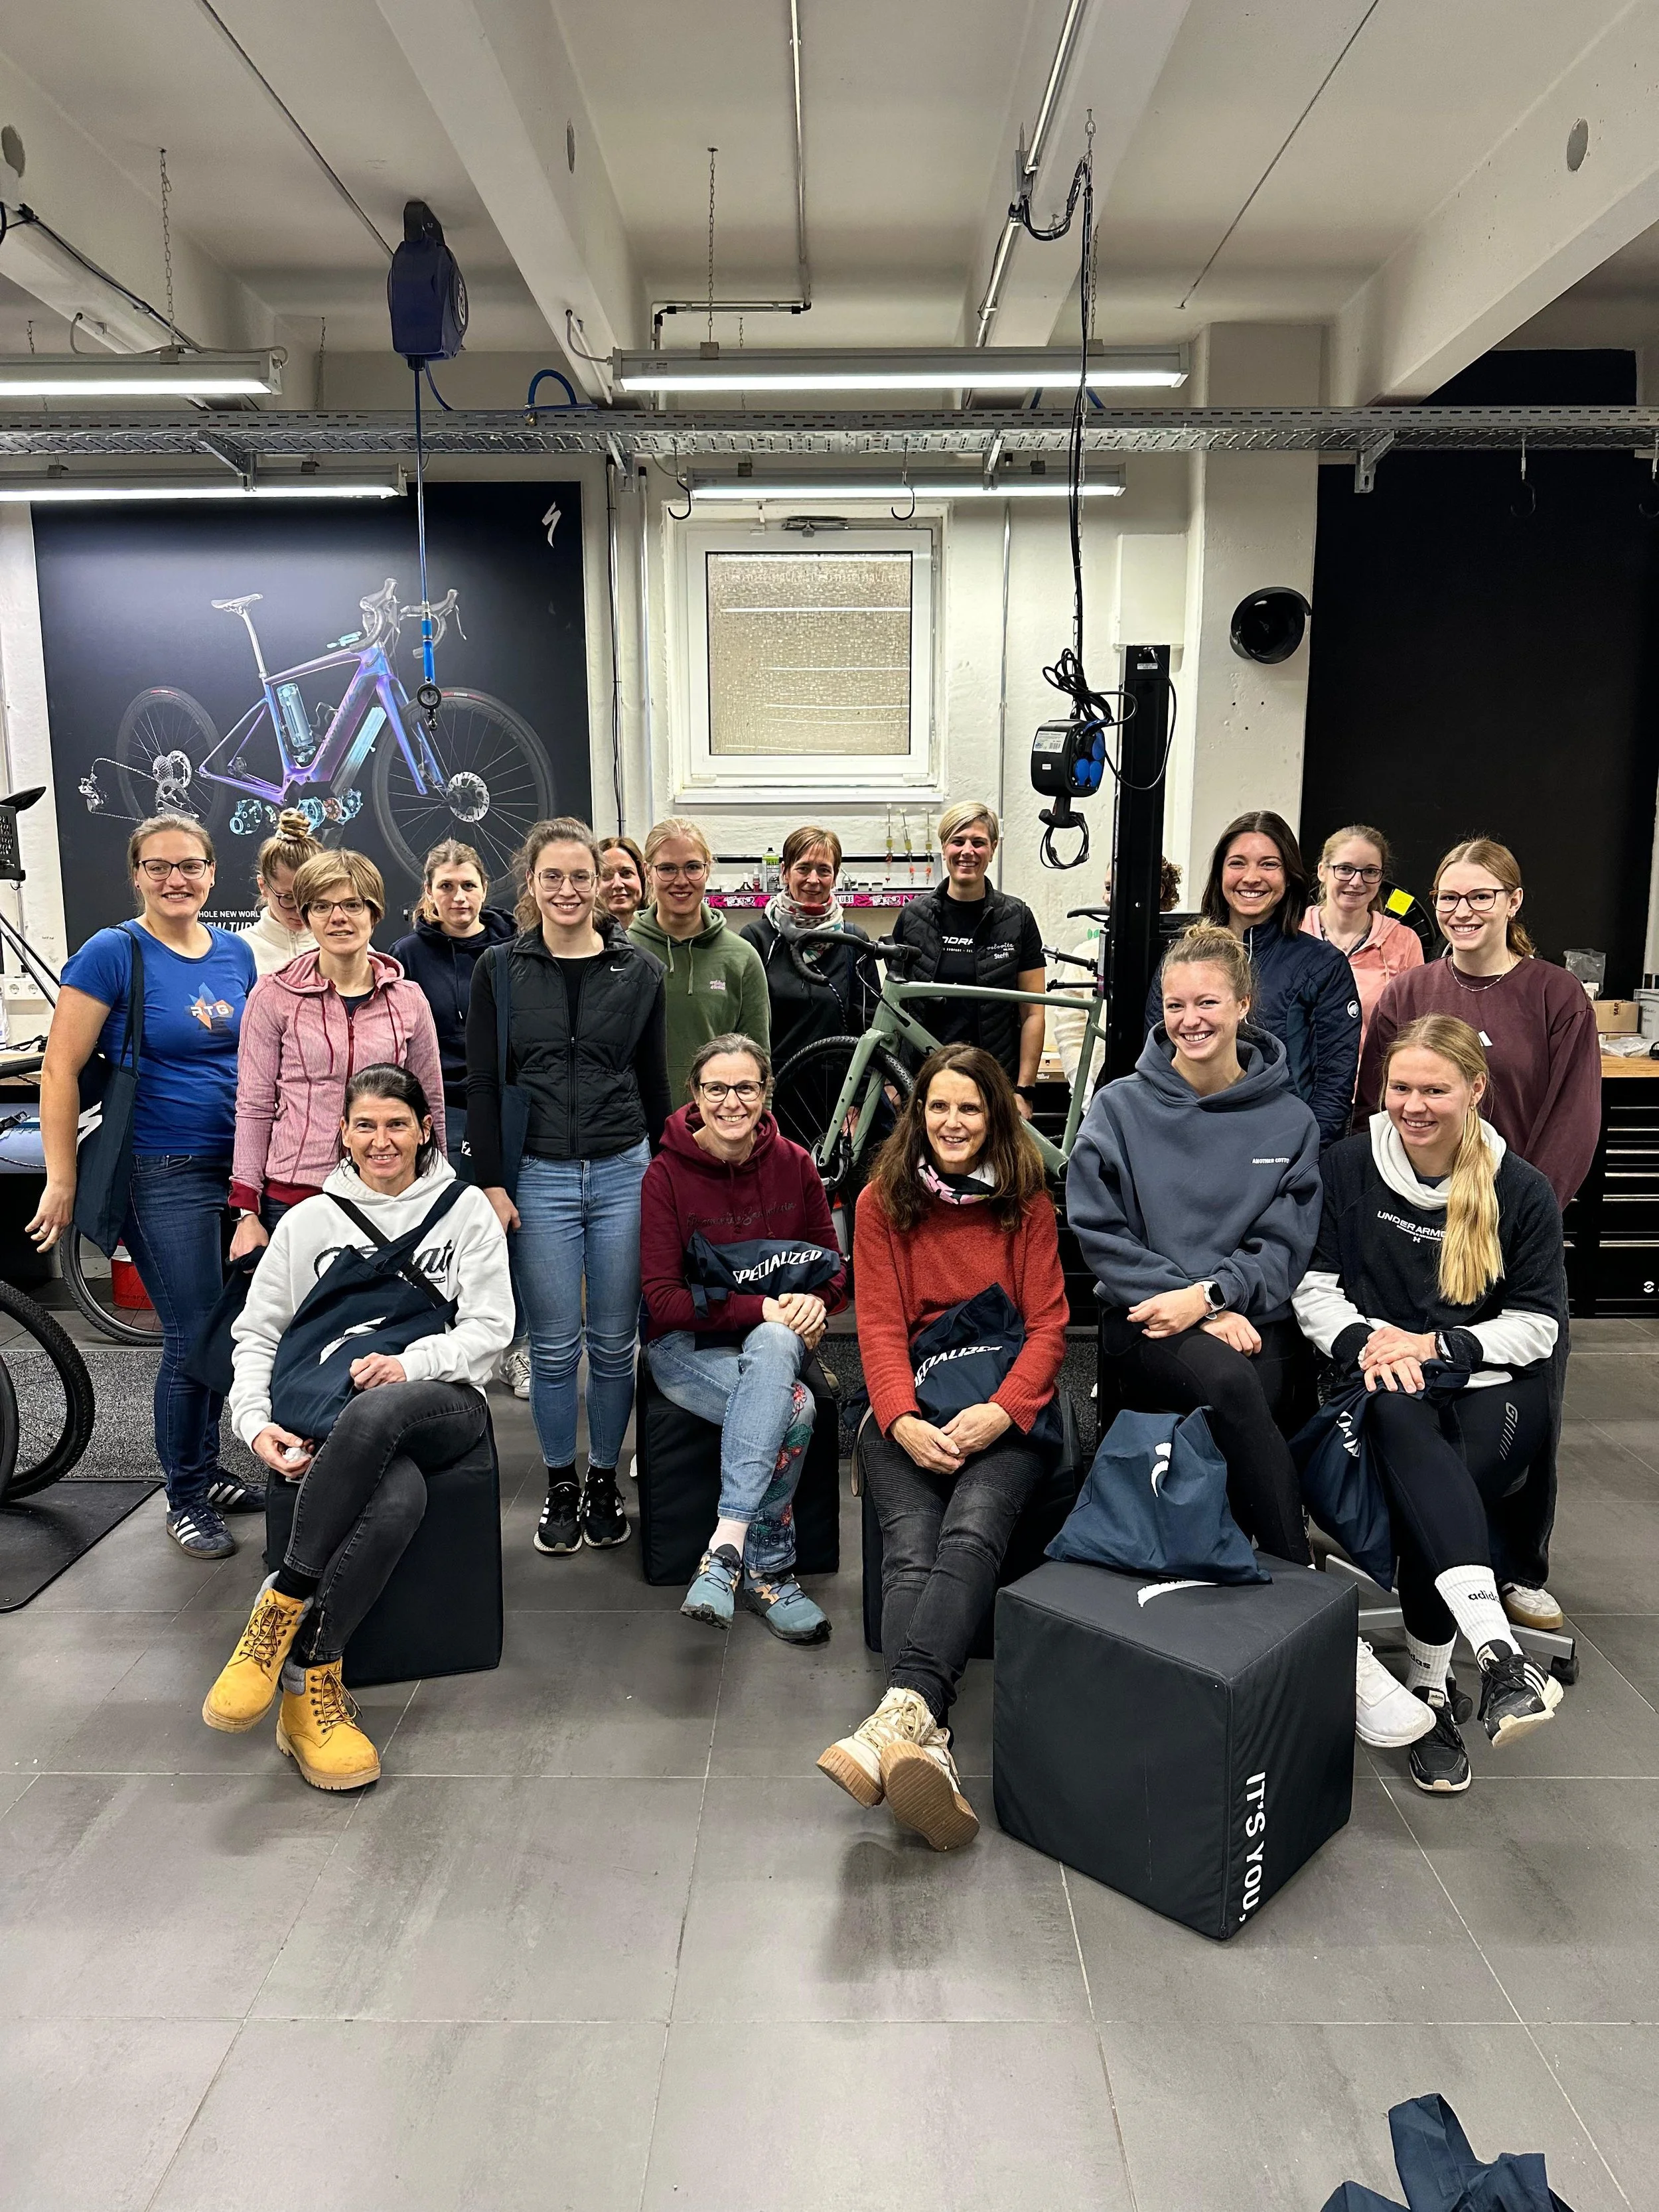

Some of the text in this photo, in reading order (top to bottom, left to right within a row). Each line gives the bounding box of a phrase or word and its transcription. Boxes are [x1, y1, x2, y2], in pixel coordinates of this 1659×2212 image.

[1377, 1211, 1416, 1230] UNDER
[1415, 1226, 1447, 1238] ARMO
[733, 1250, 822, 1284] SPECIALIZED
[1468, 1590, 1501, 1604] adida
[1238, 1771, 1266, 1922] IT'S YOU,
